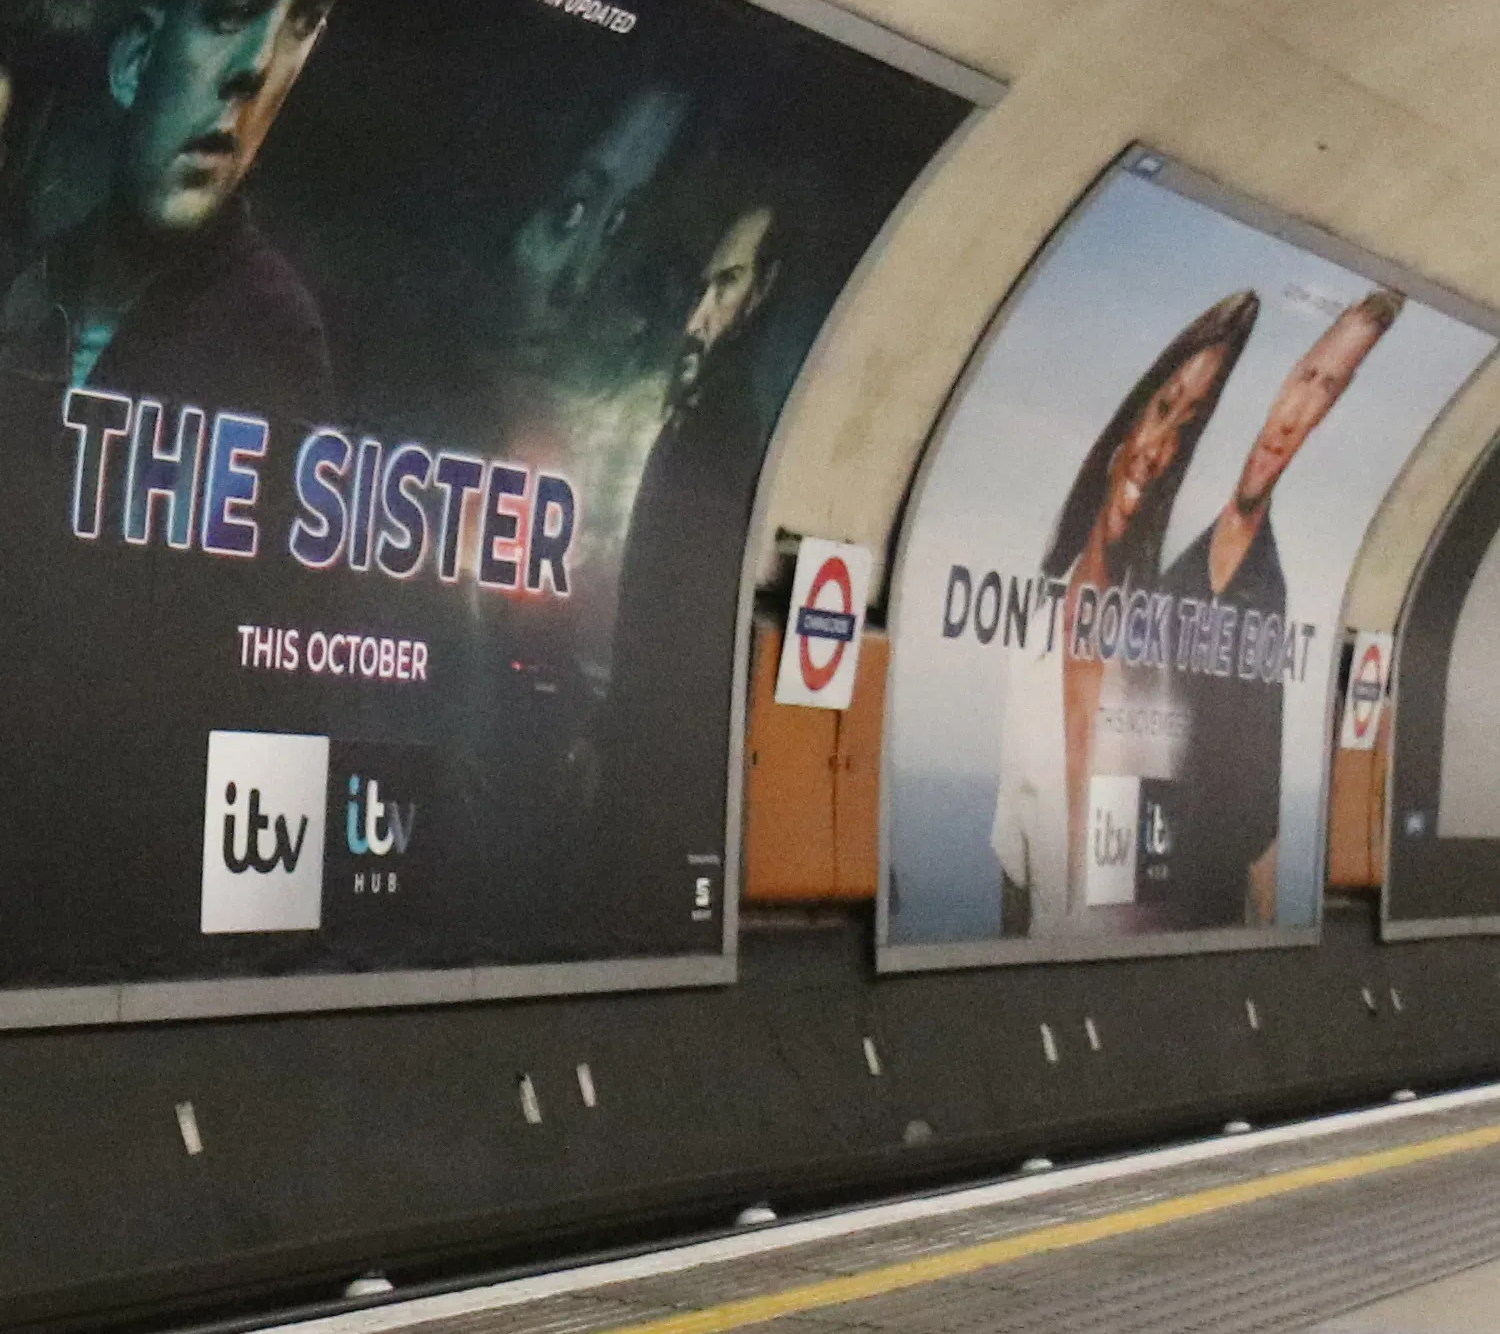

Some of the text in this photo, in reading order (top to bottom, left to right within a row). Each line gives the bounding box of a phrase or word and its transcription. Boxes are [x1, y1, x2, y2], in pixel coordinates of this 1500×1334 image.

[62, 387, 578, 599] THE SISTER
[237, 624, 430, 682] THIS OCTOBER
[941, 563, 1317, 685] DON'T ROCK THE BOAT
[222, 780, 309, 874] itv
[346, 772, 416, 857] itv
[353, 871, 397, 894] HUB
